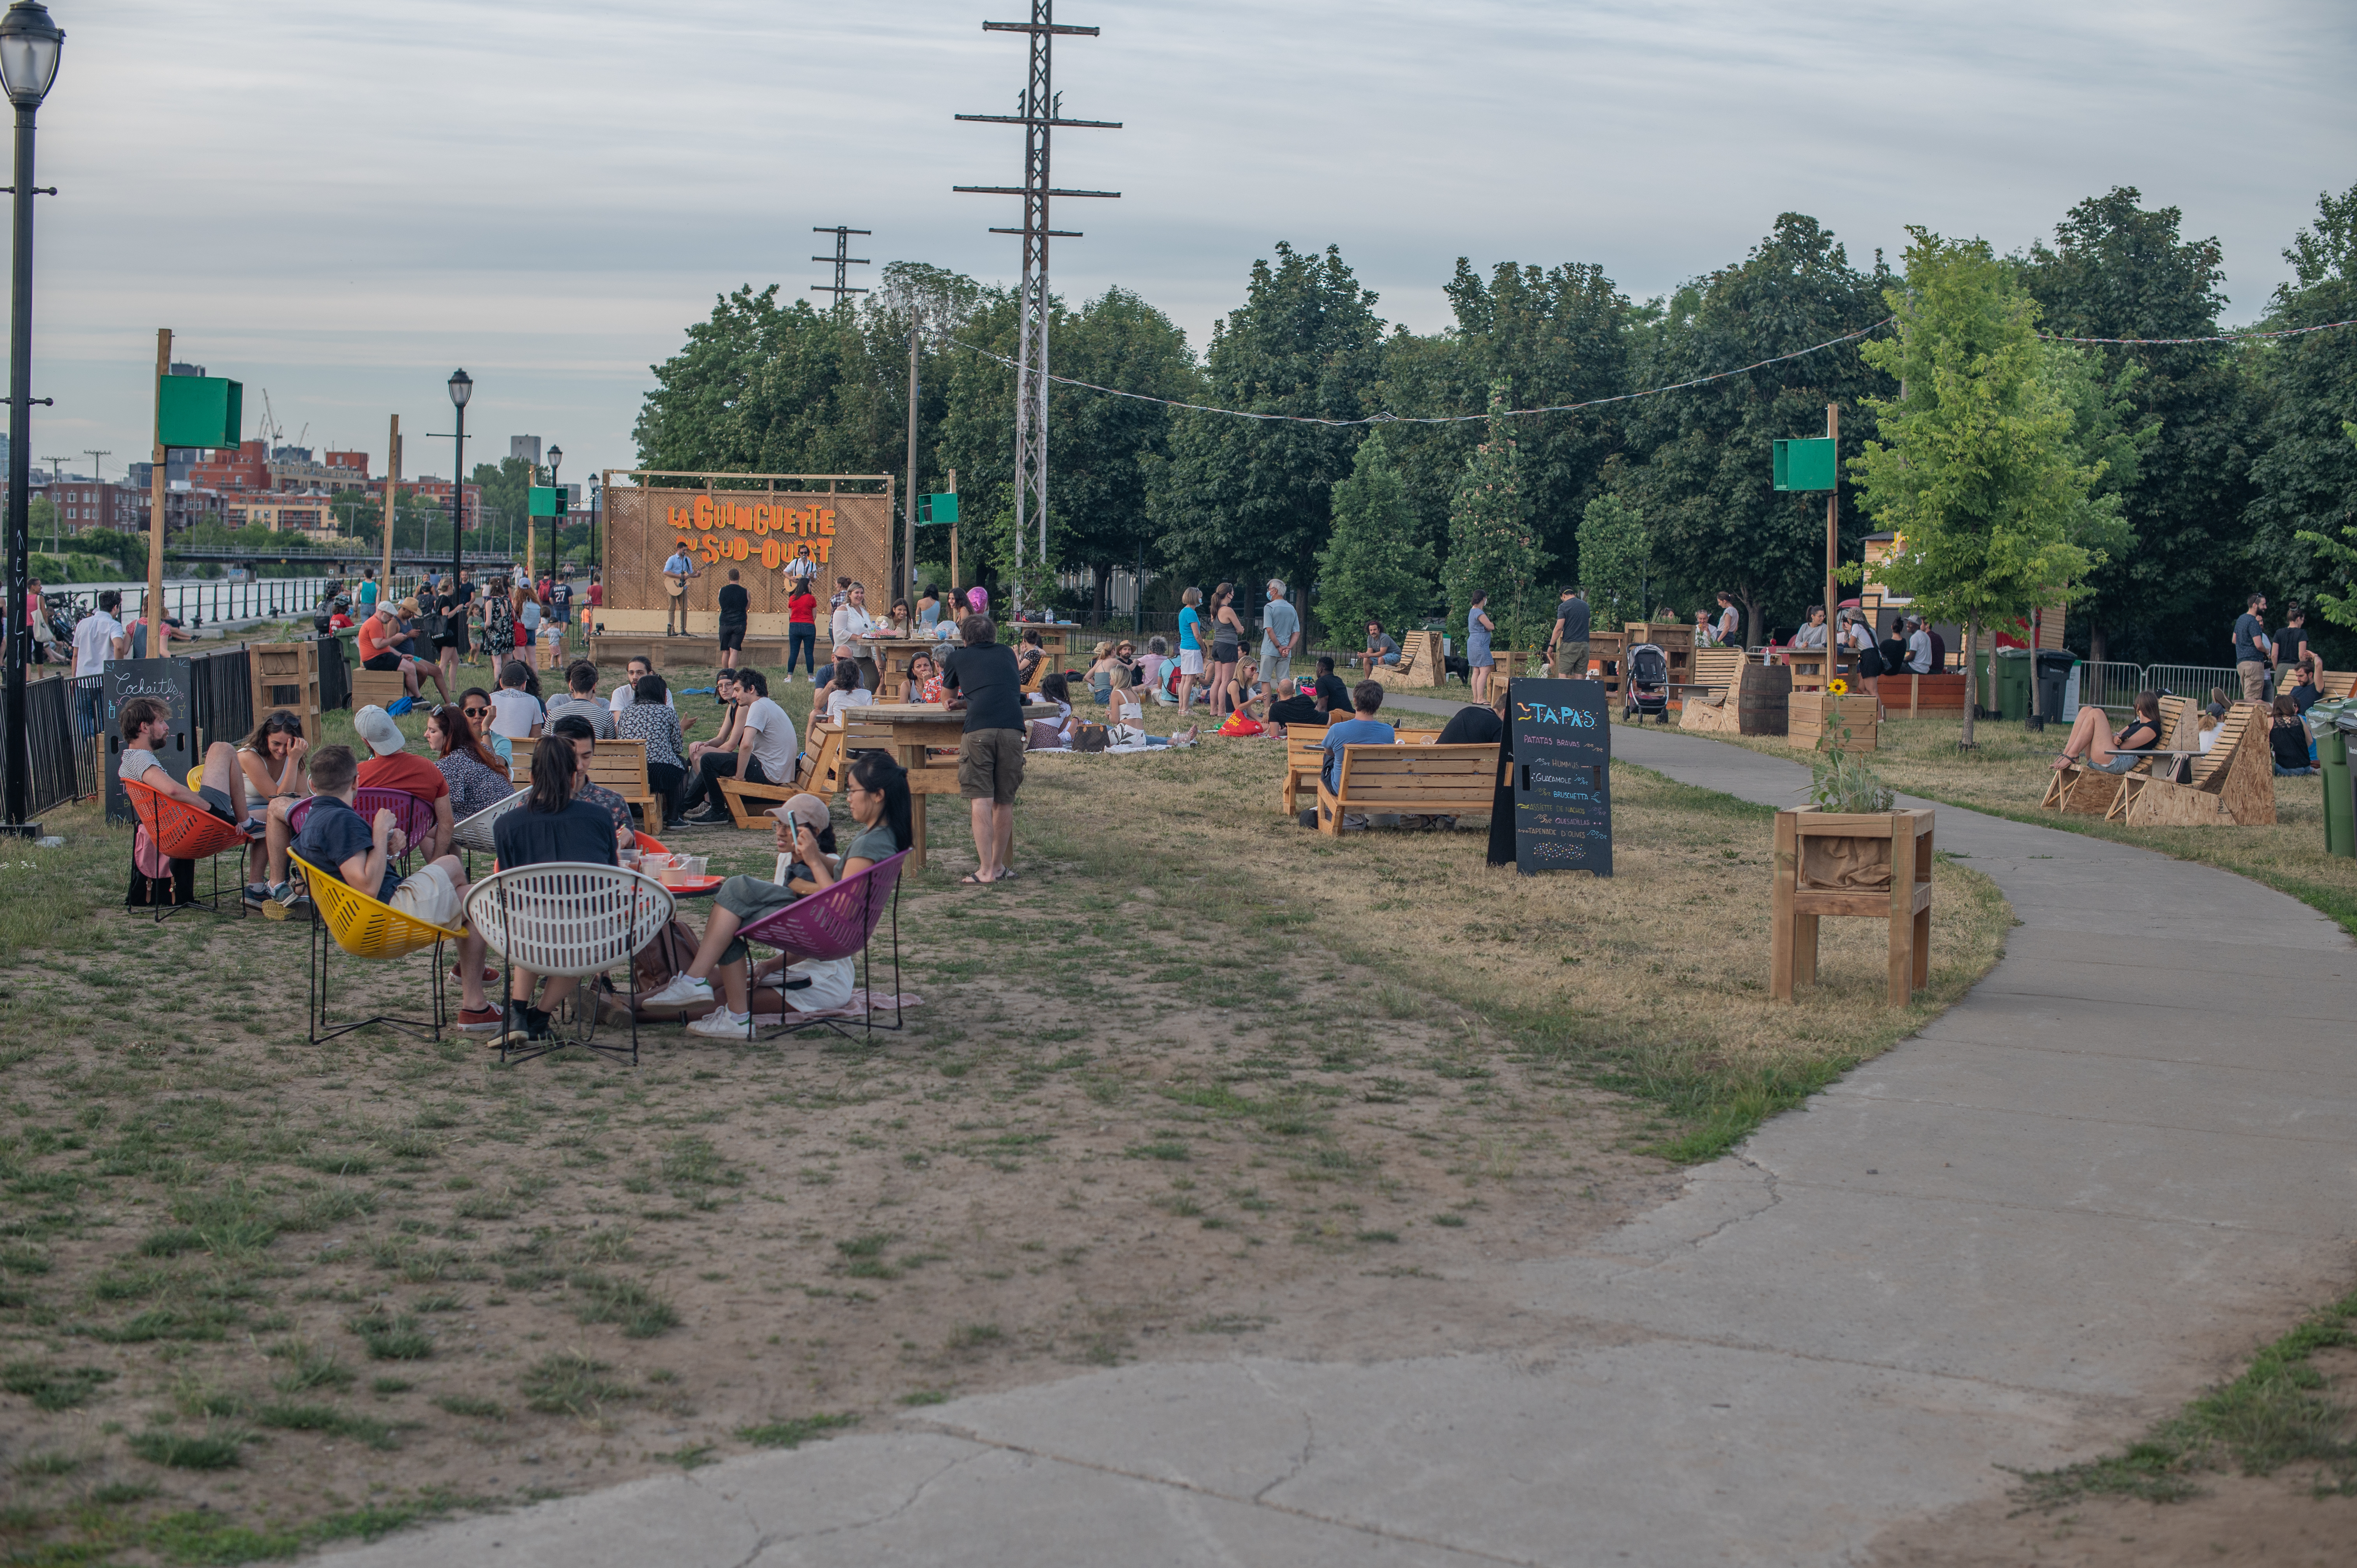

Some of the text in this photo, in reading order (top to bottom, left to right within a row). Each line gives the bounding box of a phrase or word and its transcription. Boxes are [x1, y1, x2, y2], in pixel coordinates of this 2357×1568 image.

[668, 495, 836, 537] LA GUINGUETTE
[701, 534, 832, 569] SUD-OUEST
[555, 591, 565, 602] 27
[1528, 703, 1595, 727] TAPAS
[1524, 735, 1580, 747] PATATAS BRAVAS
[1552, 759, 1579, 769] HUMMUS
[1536, 773, 1571, 784] GUACAMOLE
[1553, 791, 1588, 800] BRUSCHETTA
